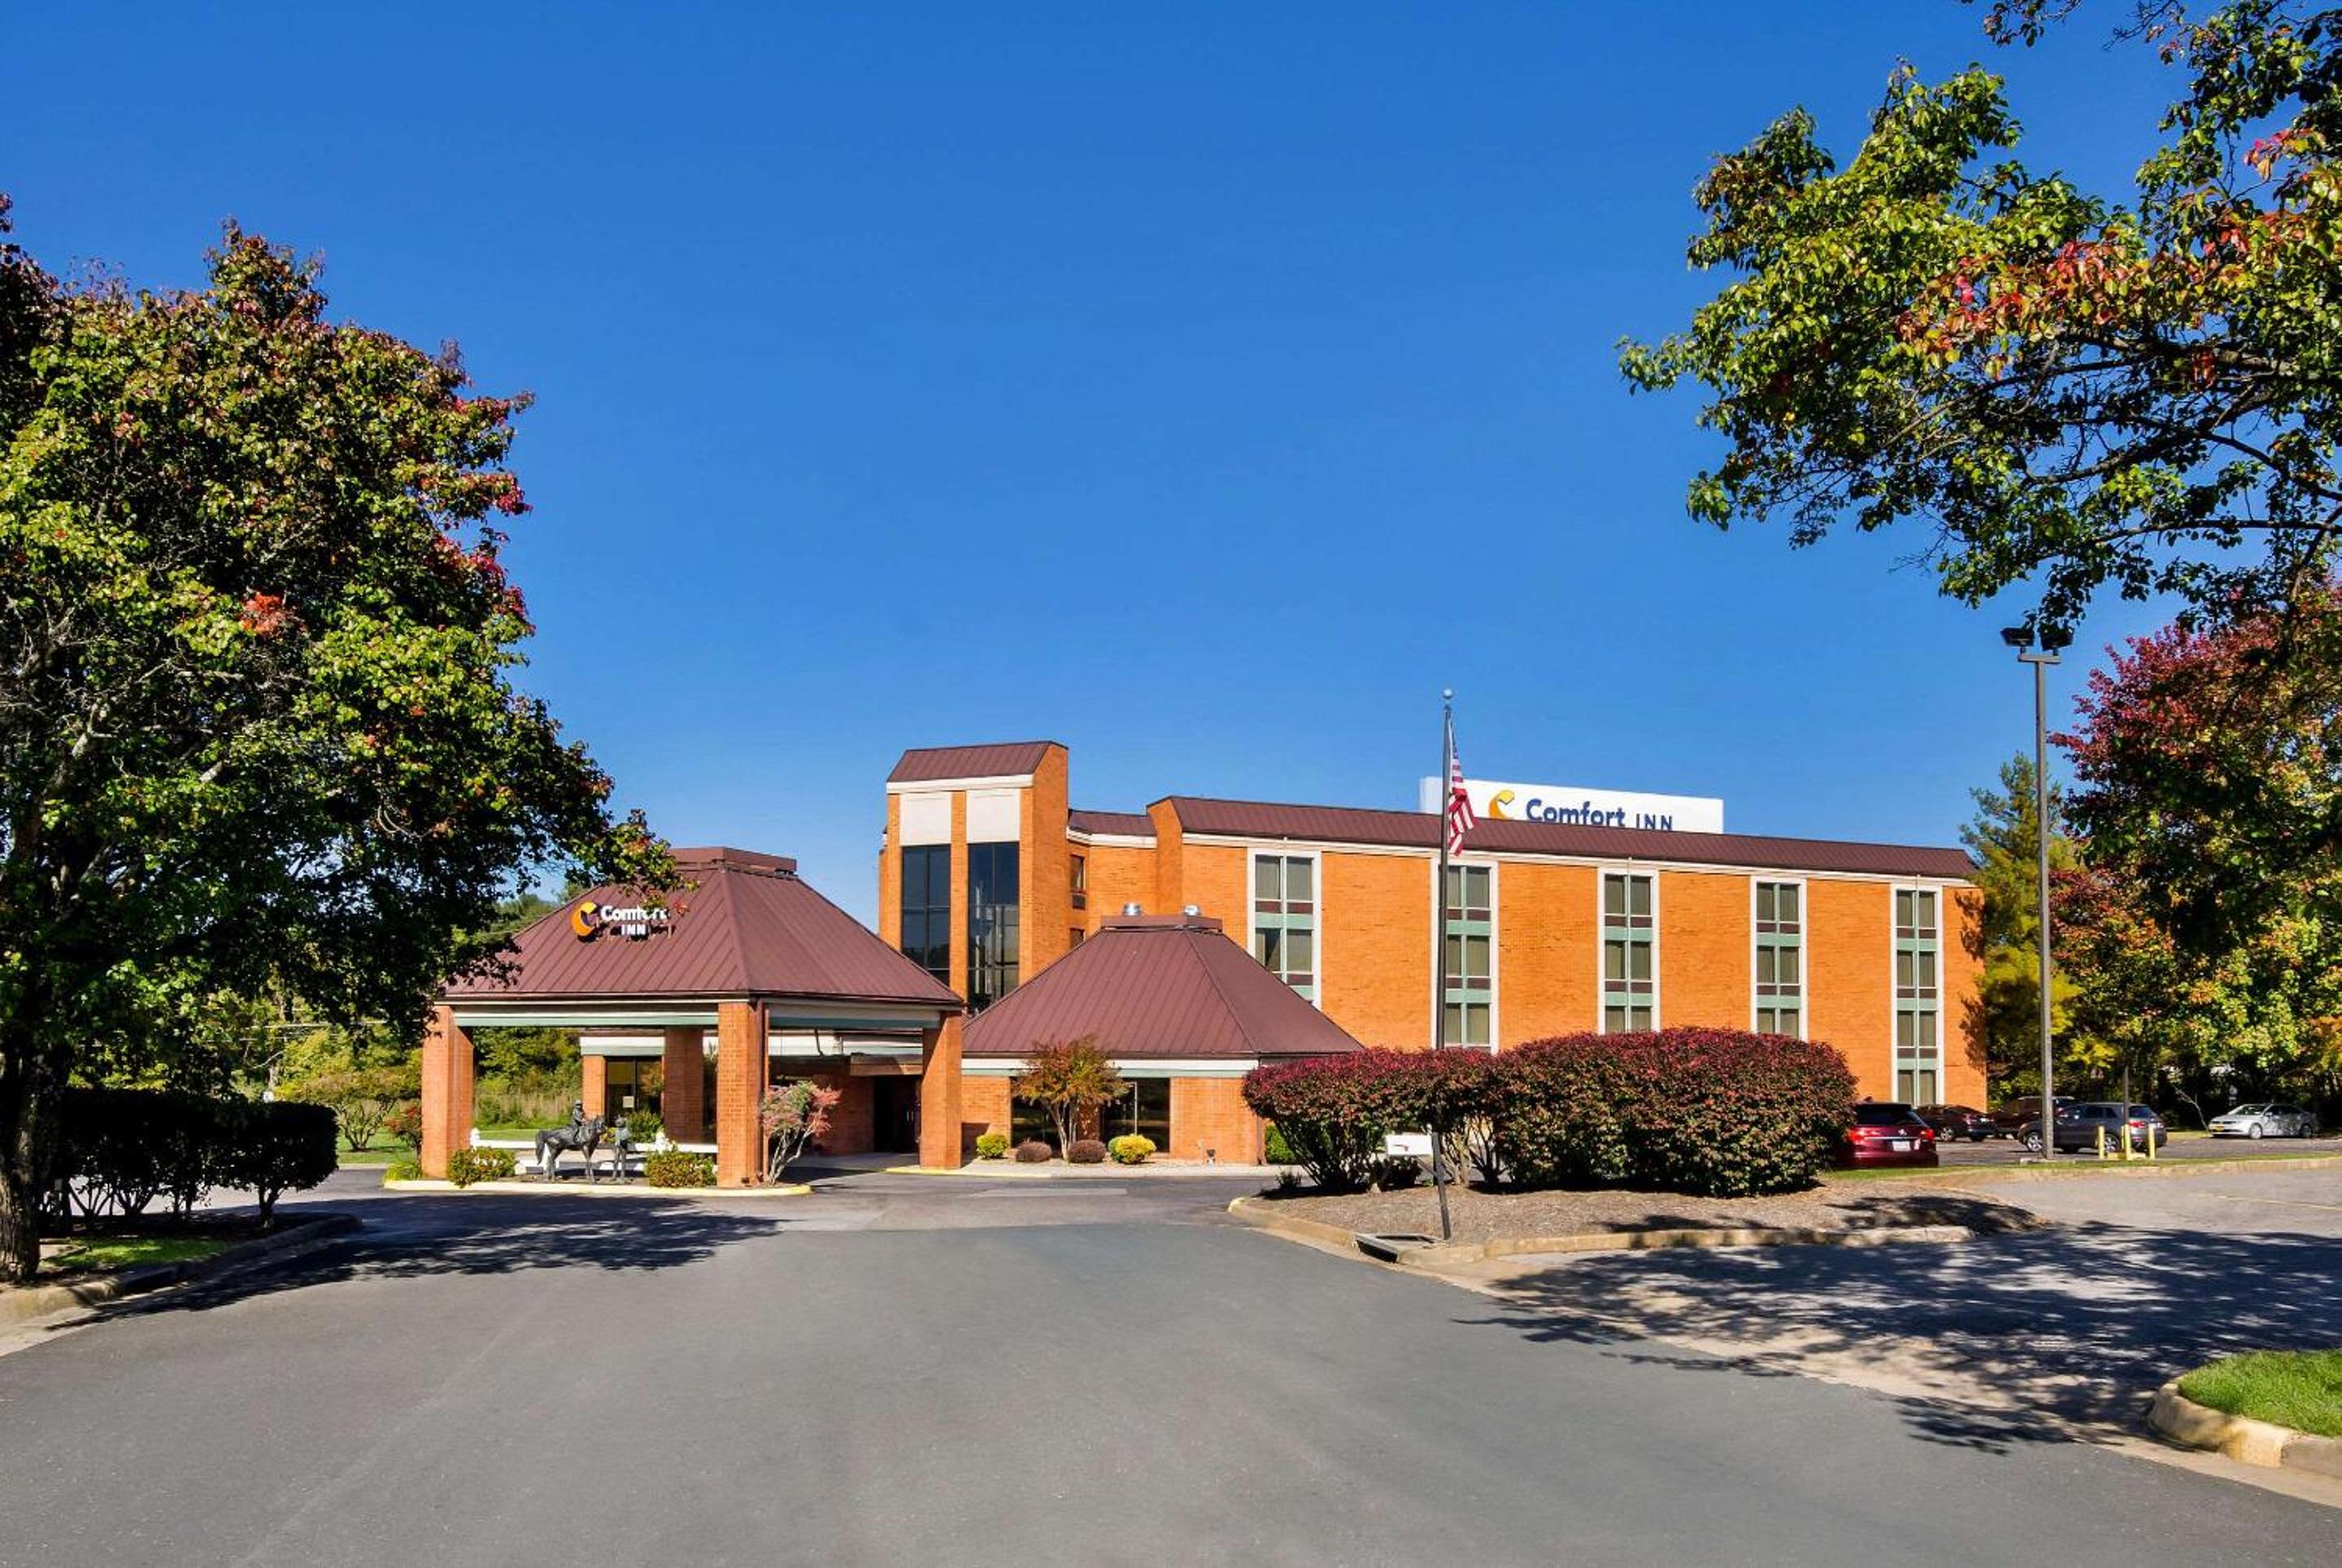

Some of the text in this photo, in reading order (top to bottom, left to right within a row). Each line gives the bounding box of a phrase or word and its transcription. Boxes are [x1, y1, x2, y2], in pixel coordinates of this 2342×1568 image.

[1526, 799, 1673, 830] Comfort INN
[620, 924, 646, 935] INN
